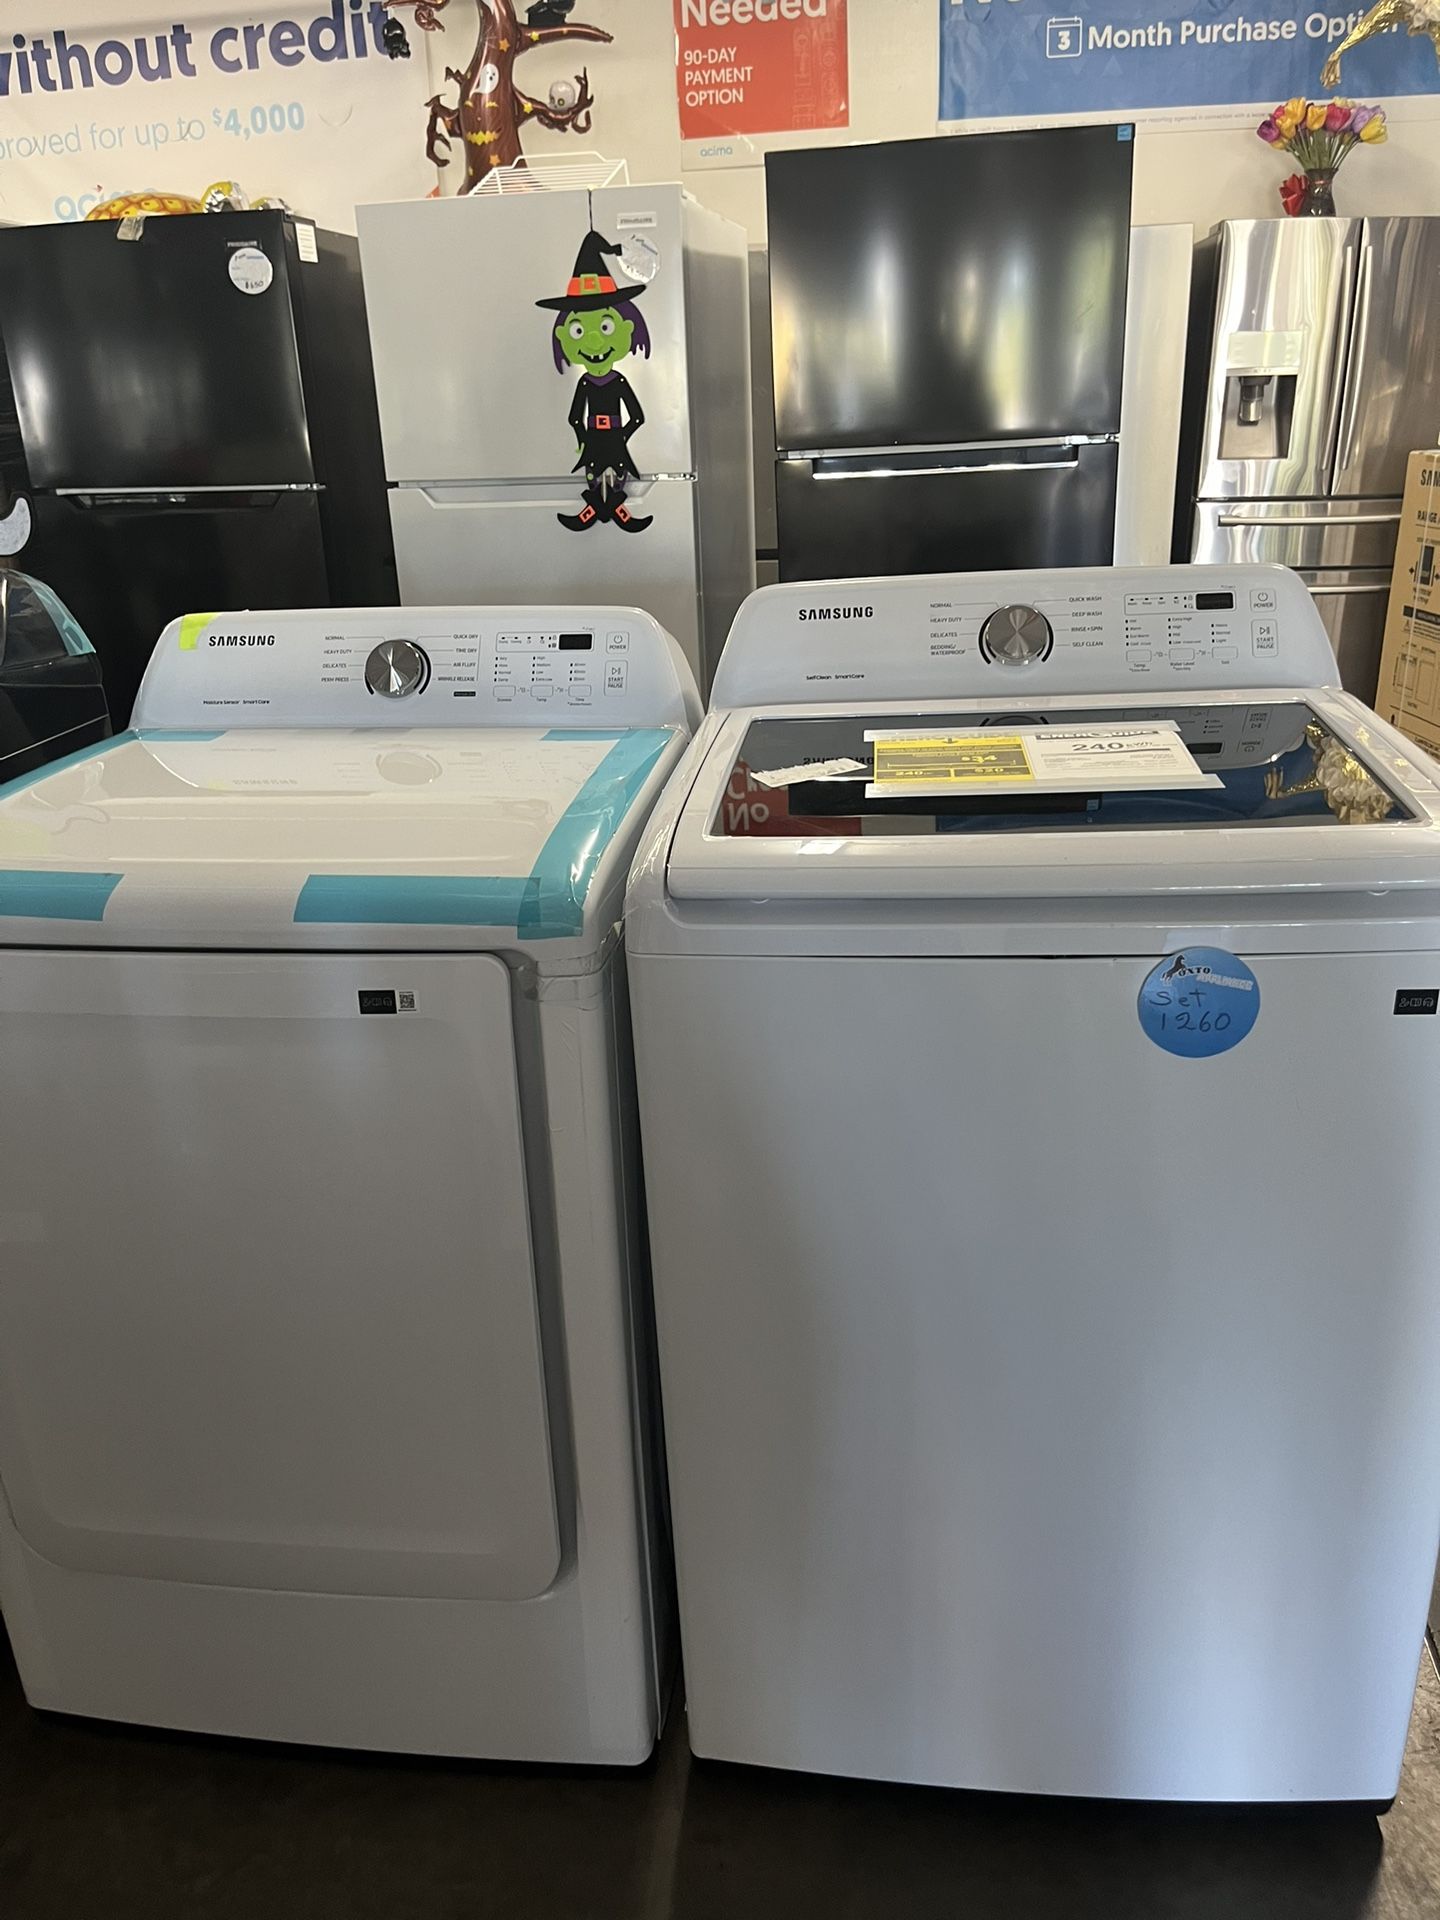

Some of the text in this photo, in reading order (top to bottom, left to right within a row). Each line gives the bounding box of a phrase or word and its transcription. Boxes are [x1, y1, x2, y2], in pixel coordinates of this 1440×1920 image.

[1057, 31, 1071, 50] 3
[1088, 21, 1172, 50] Month
[1180, 16, 1298, 45] Purchase
[0, 0, 389, 96] ithout credit
[684, 47, 737, 66] 90-DAY
[685, 66, 753, 86] PAYMENT
[685, 88, 744, 107] OPTION
[91, 122, 125, 150] for
[135, 122, 169, 151] up
[175, 117, 205, 142] to
[212, 102, 305, 140] $4,000
[700, 145, 733, 157] acima
[799, 606, 873, 621] SAMSUNG
[208, 635, 275, 646] SAMSUNG
[1072, 742, 1124, 751] 240
[1149, 988, 1206, 1008] Set
[1161, 1010, 1232, 1033] 1260
